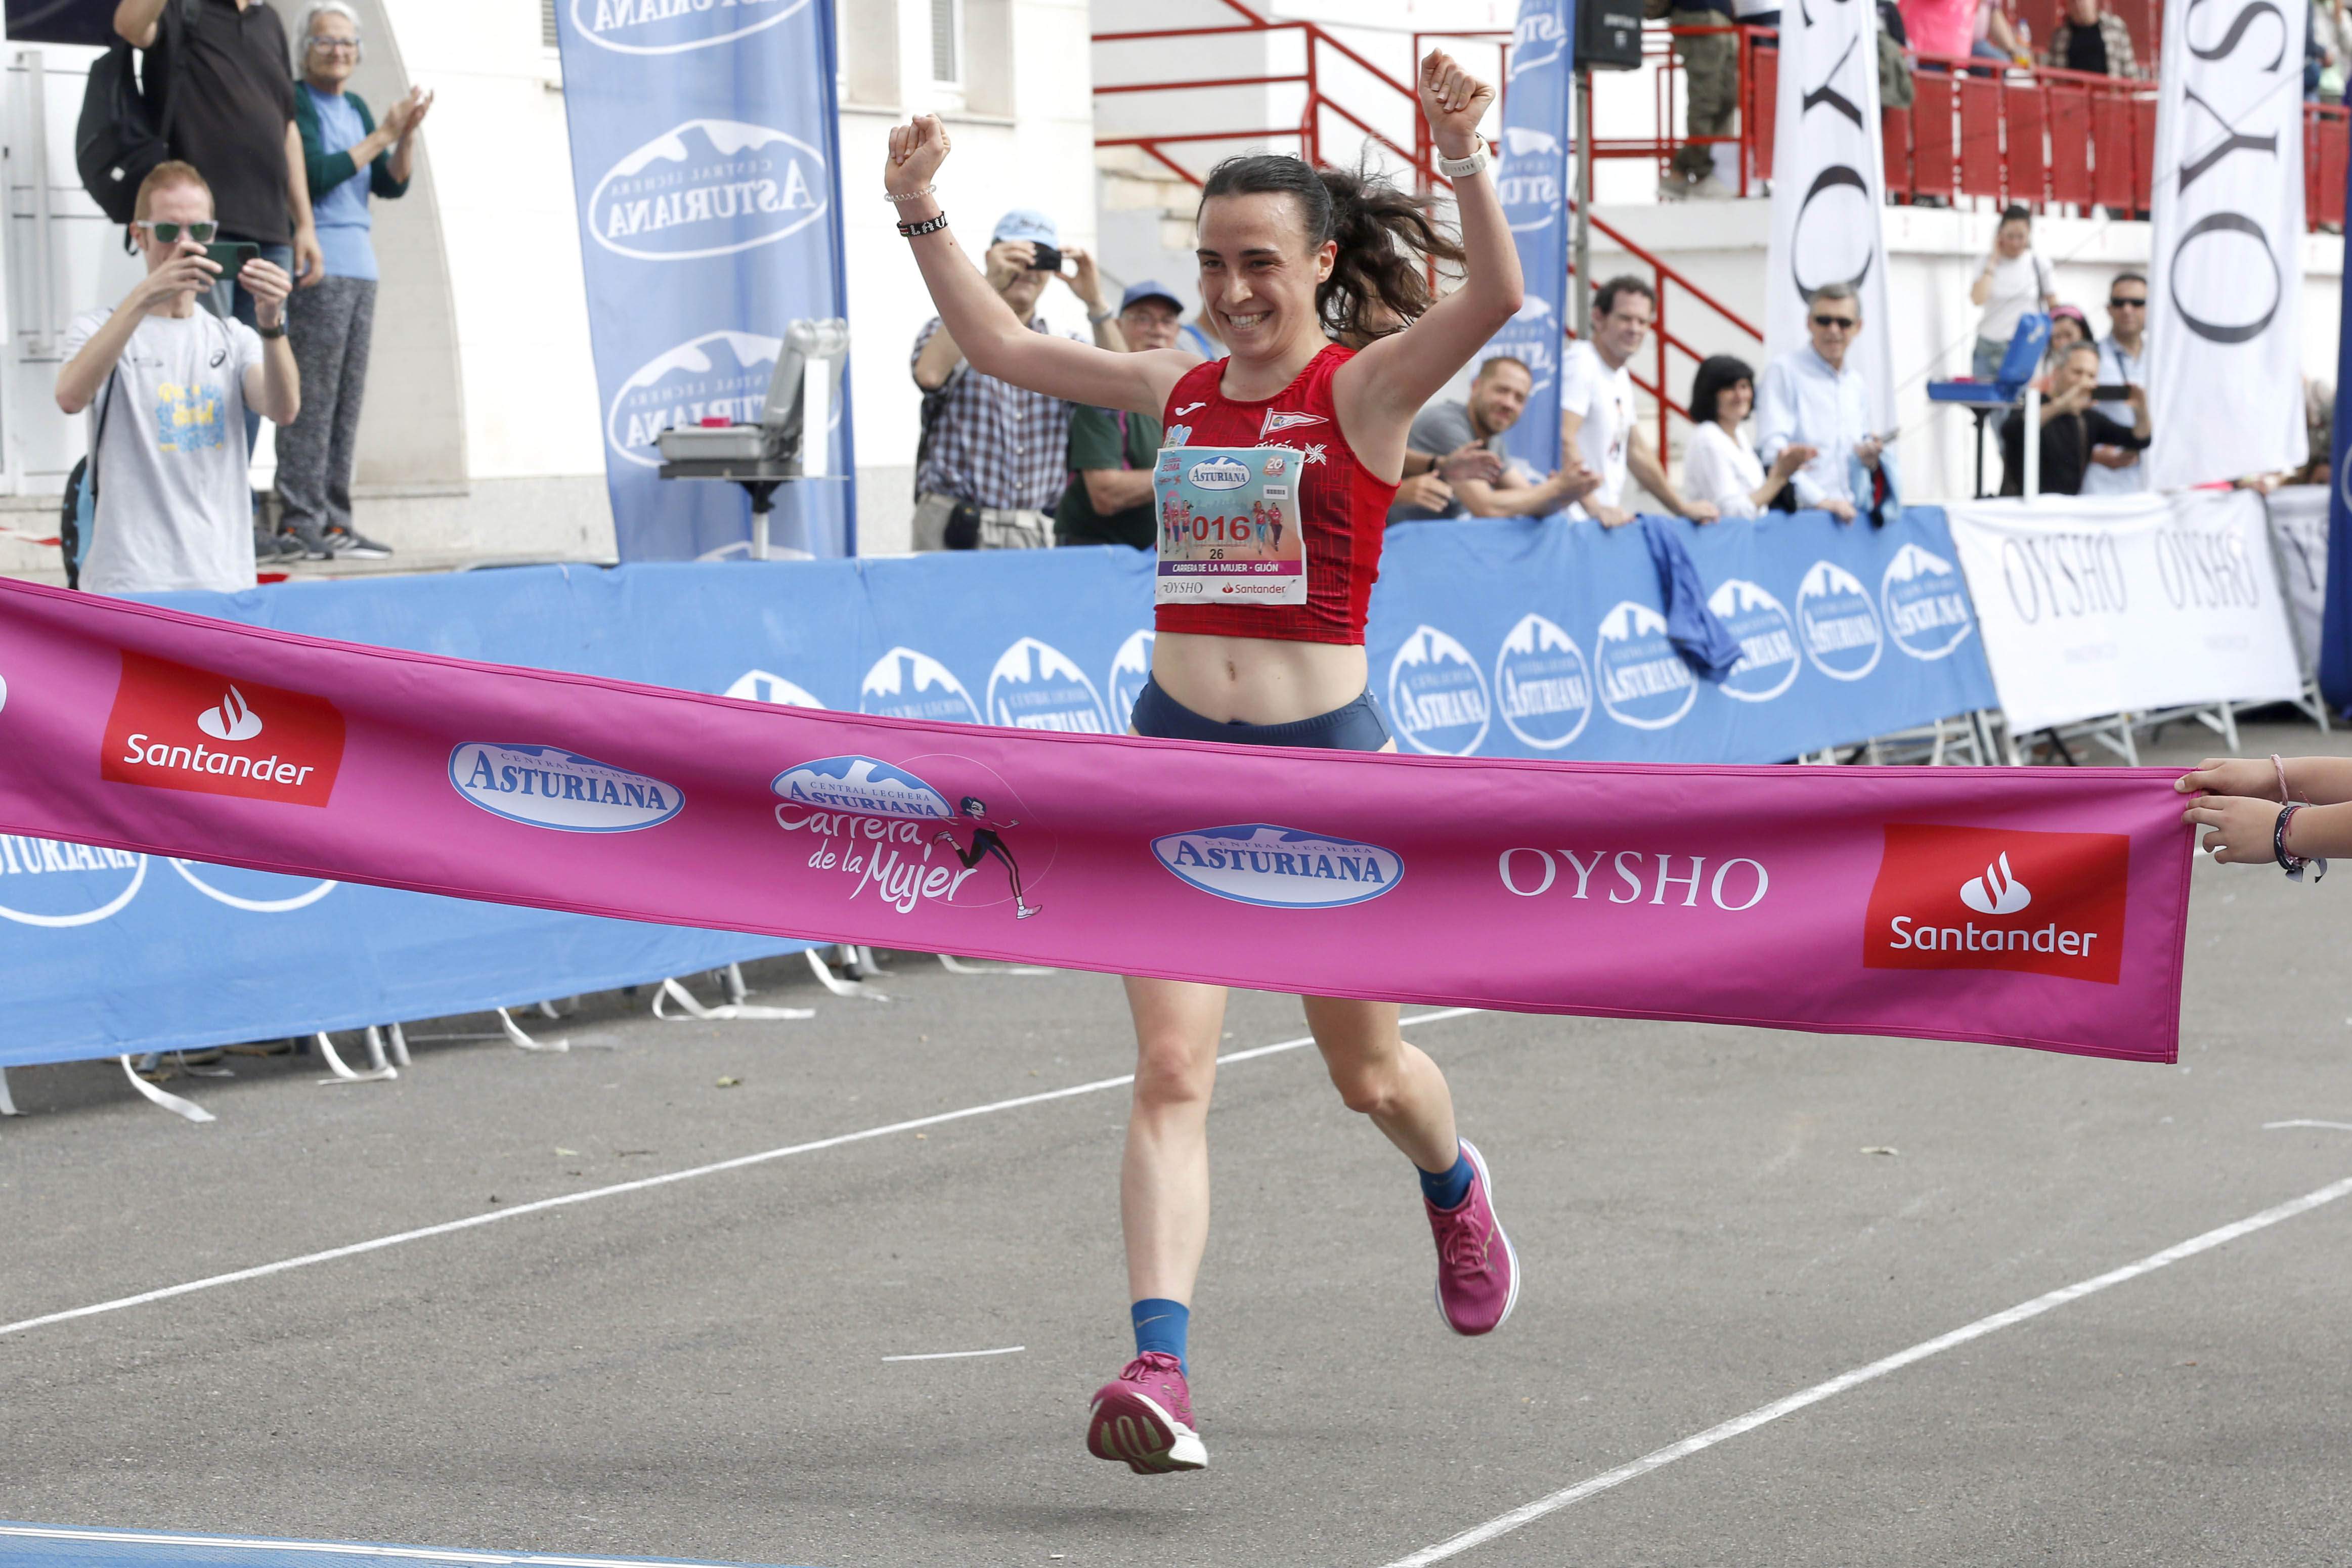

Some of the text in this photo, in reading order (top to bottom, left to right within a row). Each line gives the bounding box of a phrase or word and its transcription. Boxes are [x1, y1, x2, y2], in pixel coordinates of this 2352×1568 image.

[1192, 469, 1246, 482] ASTURIANA
[1267, 458, 1283, 469] 20
[1192, 516, 1250, 541] 016
[1172, 564, 1197, 572] CARRERA
[1254, 562, 1279, 572] GIJÓN
[1209, 549, 1224, 559] 26
[1164, 582, 1203, 594] OYSHO
[1235, 584, 1286, 594] Santander
[2001, 530, 2127, 625] OYSHO
[124, 734, 313, 785] Santander
[501, 752, 652, 783] CENTRAL LECHERA
[465, 750, 667, 810] ASTURIANA
[810, 781, 930, 801] CENTRAL LECHERA
[790, 780, 940, 817] ASTURIANA
[774, 803, 922, 844] Carrera
[1173, 840, 1385, 884] ASTURIANA
[1204, 840, 1373, 854] CENTRAL LECHERA
[808, 839, 978, 914] de la Mujer
[1499, 848, 1769, 910] OYSHO
[1890, 916, 2098, 957] Santander
